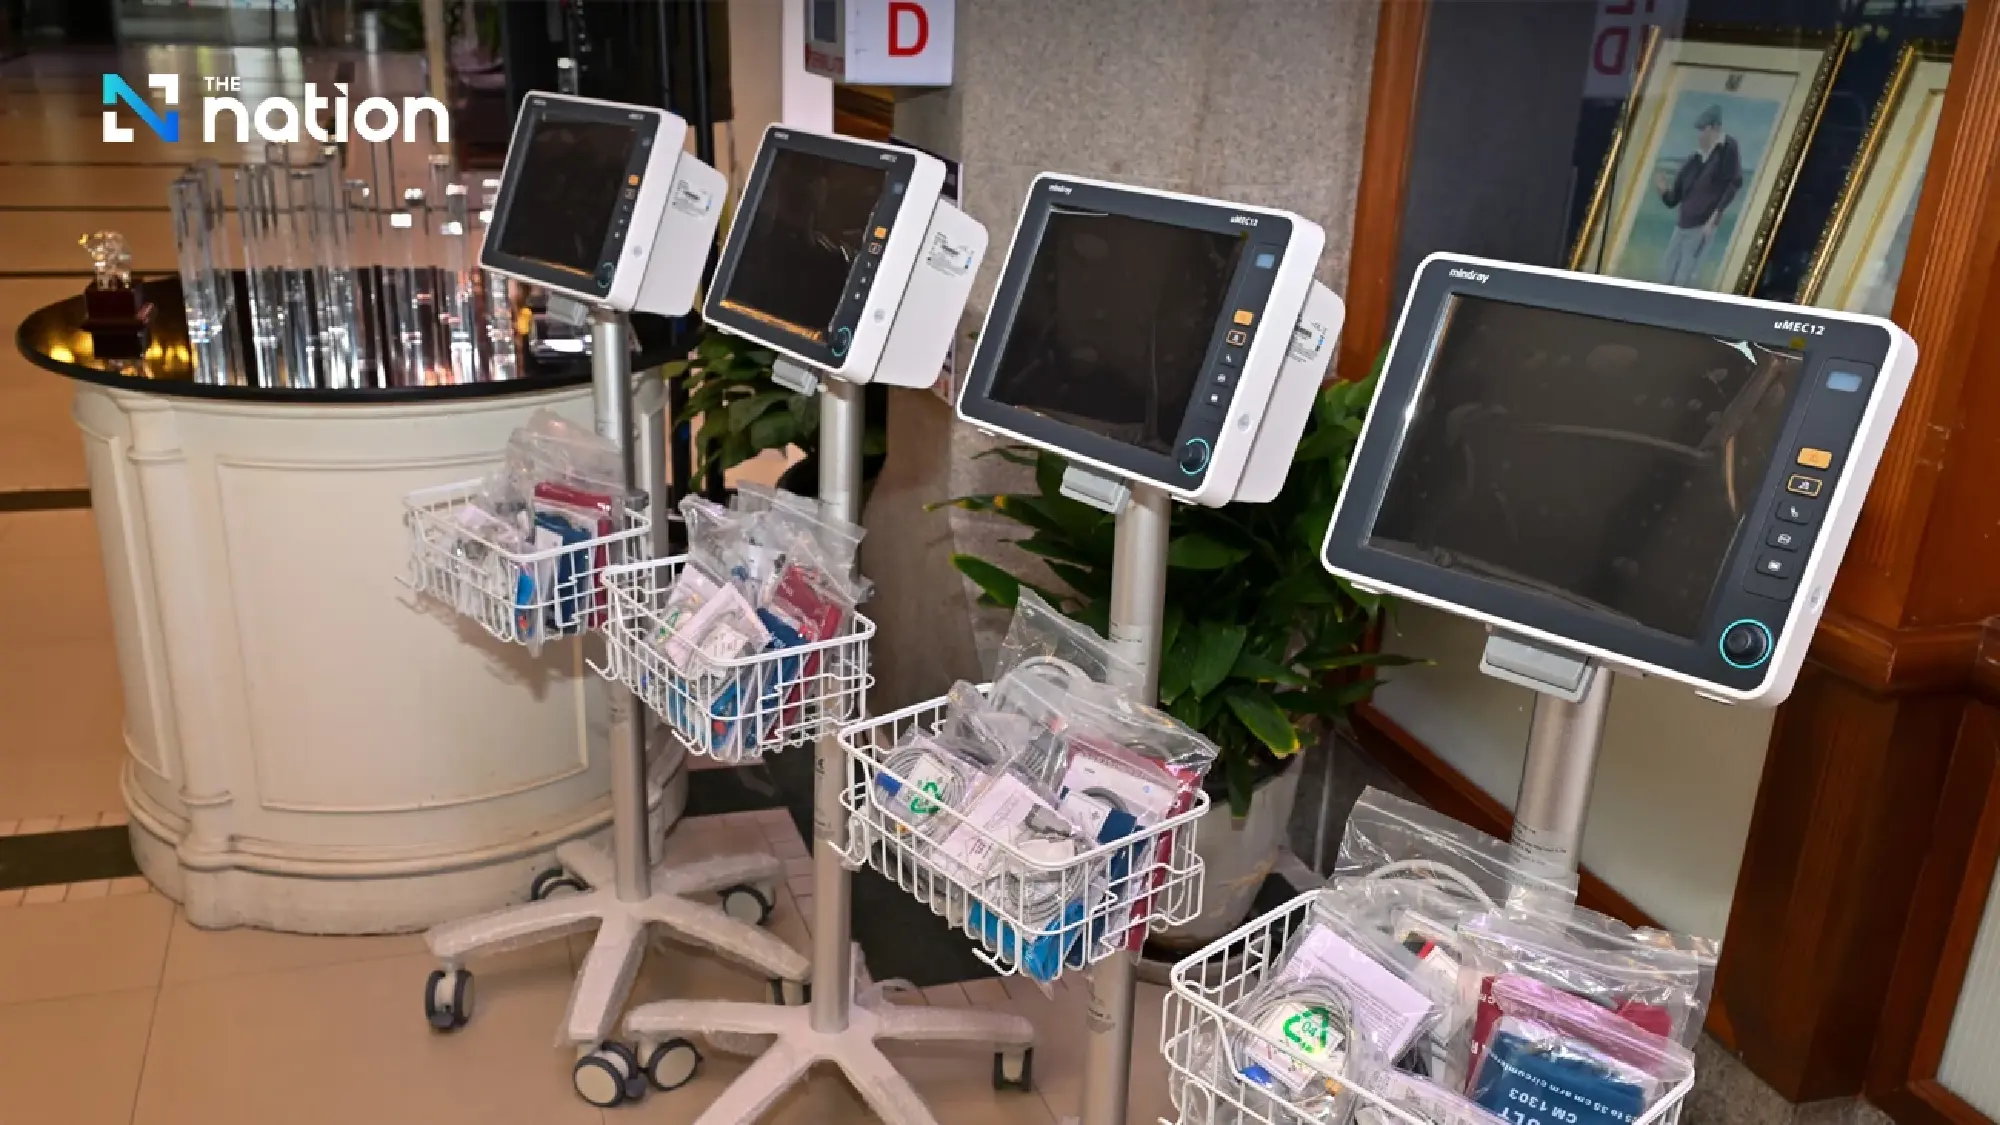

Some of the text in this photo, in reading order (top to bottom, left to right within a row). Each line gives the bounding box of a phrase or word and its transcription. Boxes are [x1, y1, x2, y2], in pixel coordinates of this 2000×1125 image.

[888, 2, 929, 57] D
[1449, 268, 1490, 284] mindray
[1774, 320, 1826, 336] uMEC12
[1549, 1084, 1572, 1098] arm
[1508, 1088, 1578, 1124] CM 1303
